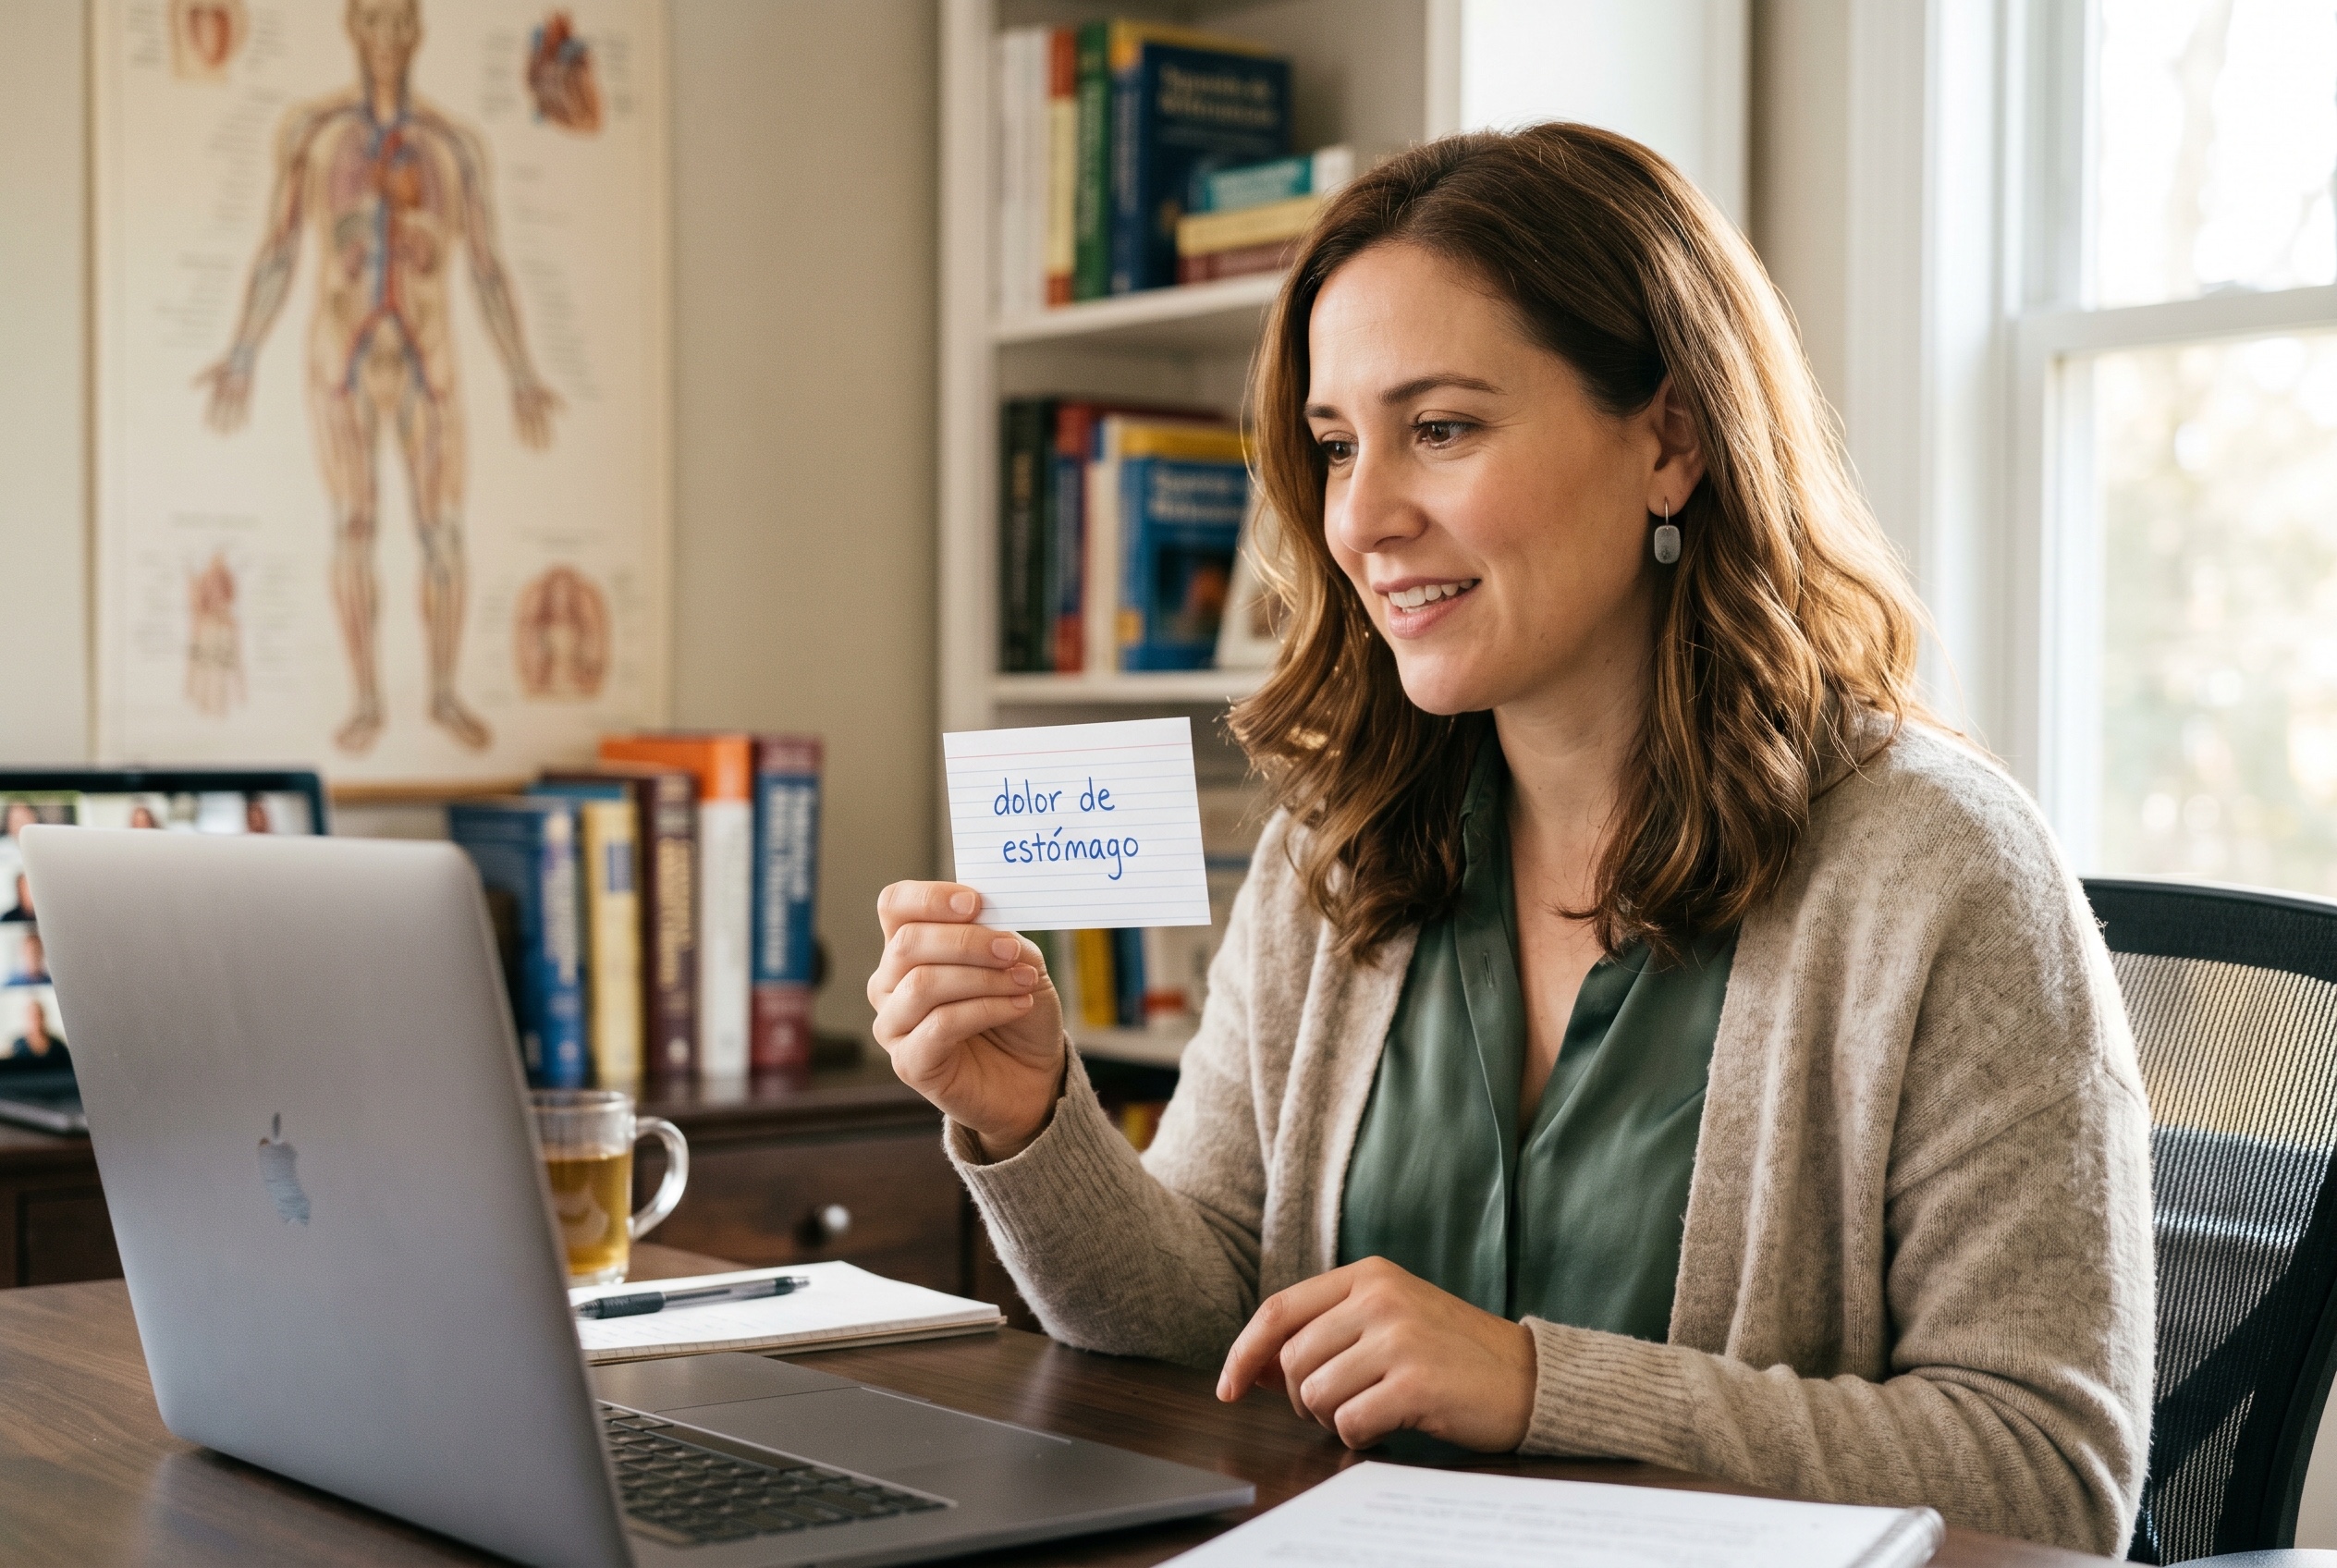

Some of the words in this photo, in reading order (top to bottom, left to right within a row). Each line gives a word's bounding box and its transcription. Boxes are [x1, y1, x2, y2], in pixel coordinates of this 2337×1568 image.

[994, 777, 1062, 815] dolor
[1080, 777, 1115, 812] de
[1003, 826, 1139, 880] estómago
